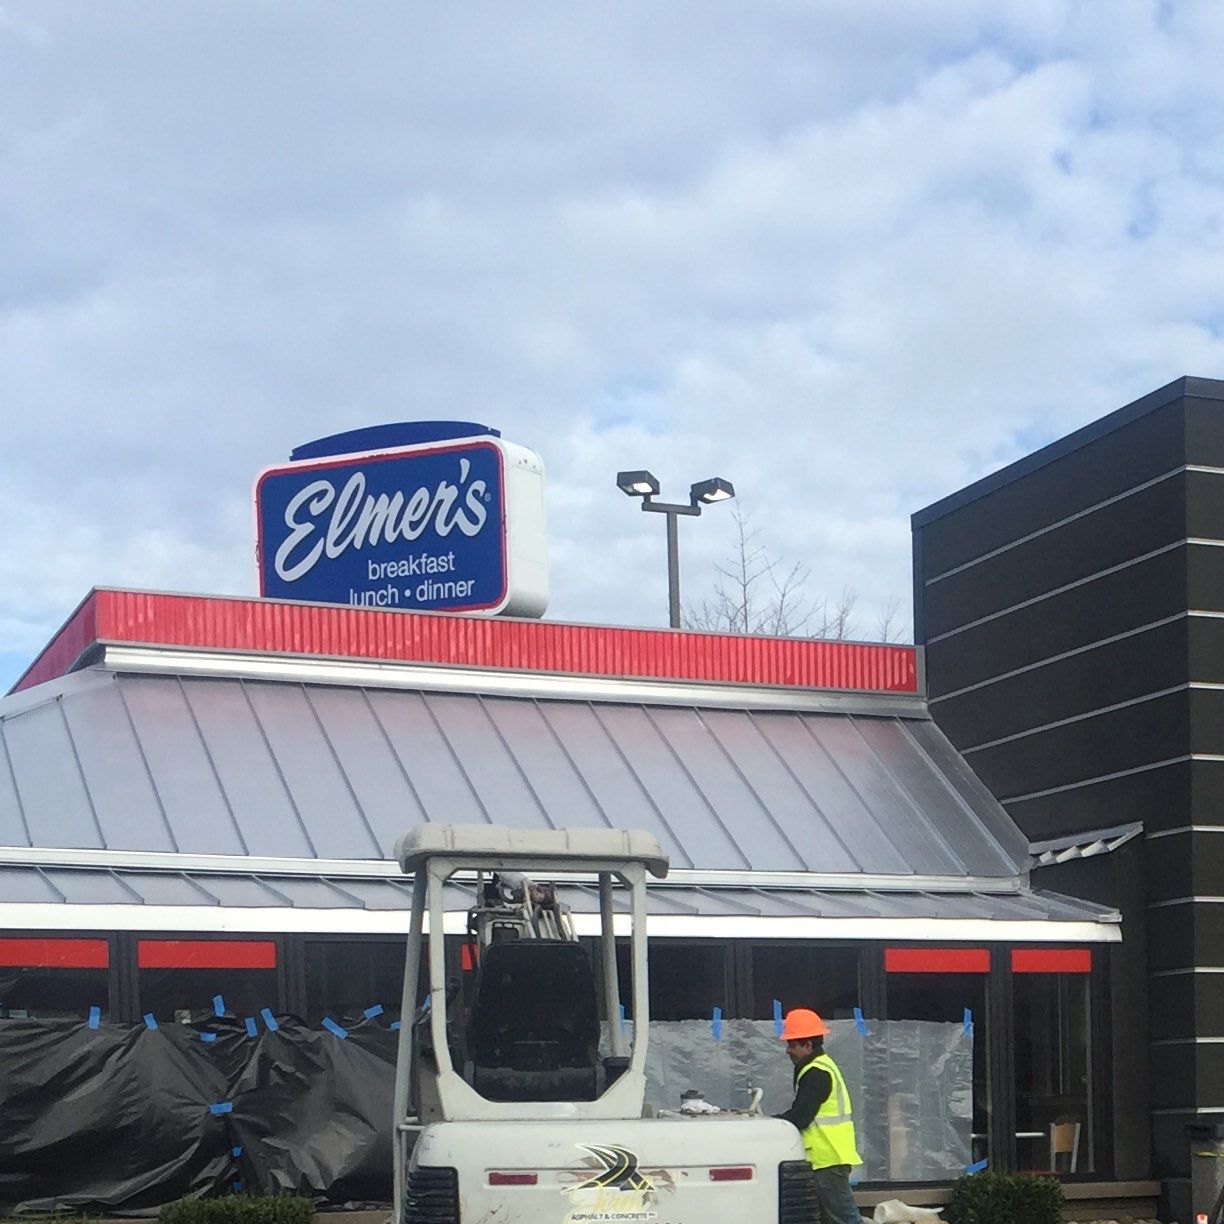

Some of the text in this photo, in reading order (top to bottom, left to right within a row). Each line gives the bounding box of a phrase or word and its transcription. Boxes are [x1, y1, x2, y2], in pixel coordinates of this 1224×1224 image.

[275, 458, 487, 582] Elmer's
[367, 552, 456, 580] breakfast
[350, 579, 475, 606] lunch dinner
[611, 1212, 647, 1220] CONCRETE
